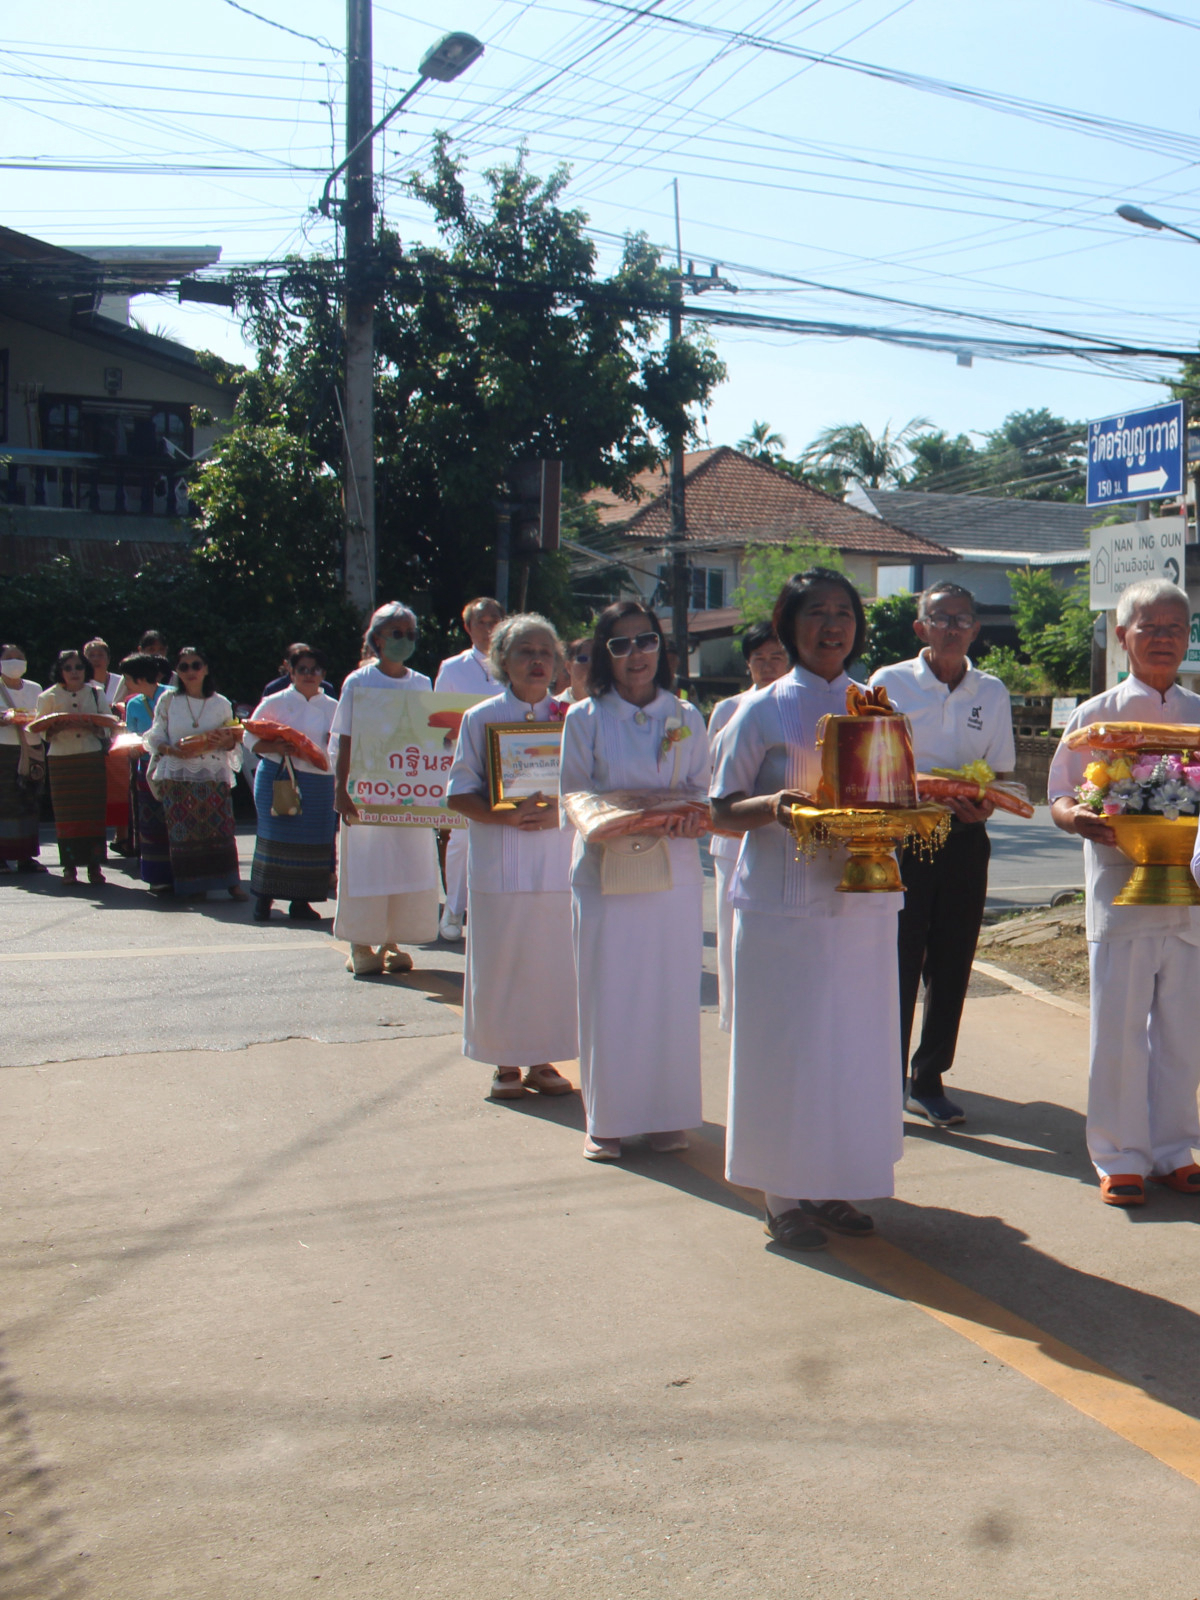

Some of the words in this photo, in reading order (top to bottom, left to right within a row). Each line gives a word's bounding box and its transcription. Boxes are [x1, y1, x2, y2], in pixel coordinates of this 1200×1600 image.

[1091, 416, 1178, 468] วัดอรัญญาวาส
[1097, 479, 1112, 498] 150
[1114, 480, 1123, 495] ม.
[1114, 537, 1133, 553] NAN
[1139, 535, 1155, 550] ING
[1161, 531, 1182, 549] OUN
[1114, 554, 1155, 576] น่านอิงอุ่น
[357, 781, 444, 798] ๓๐,๐๐๐
